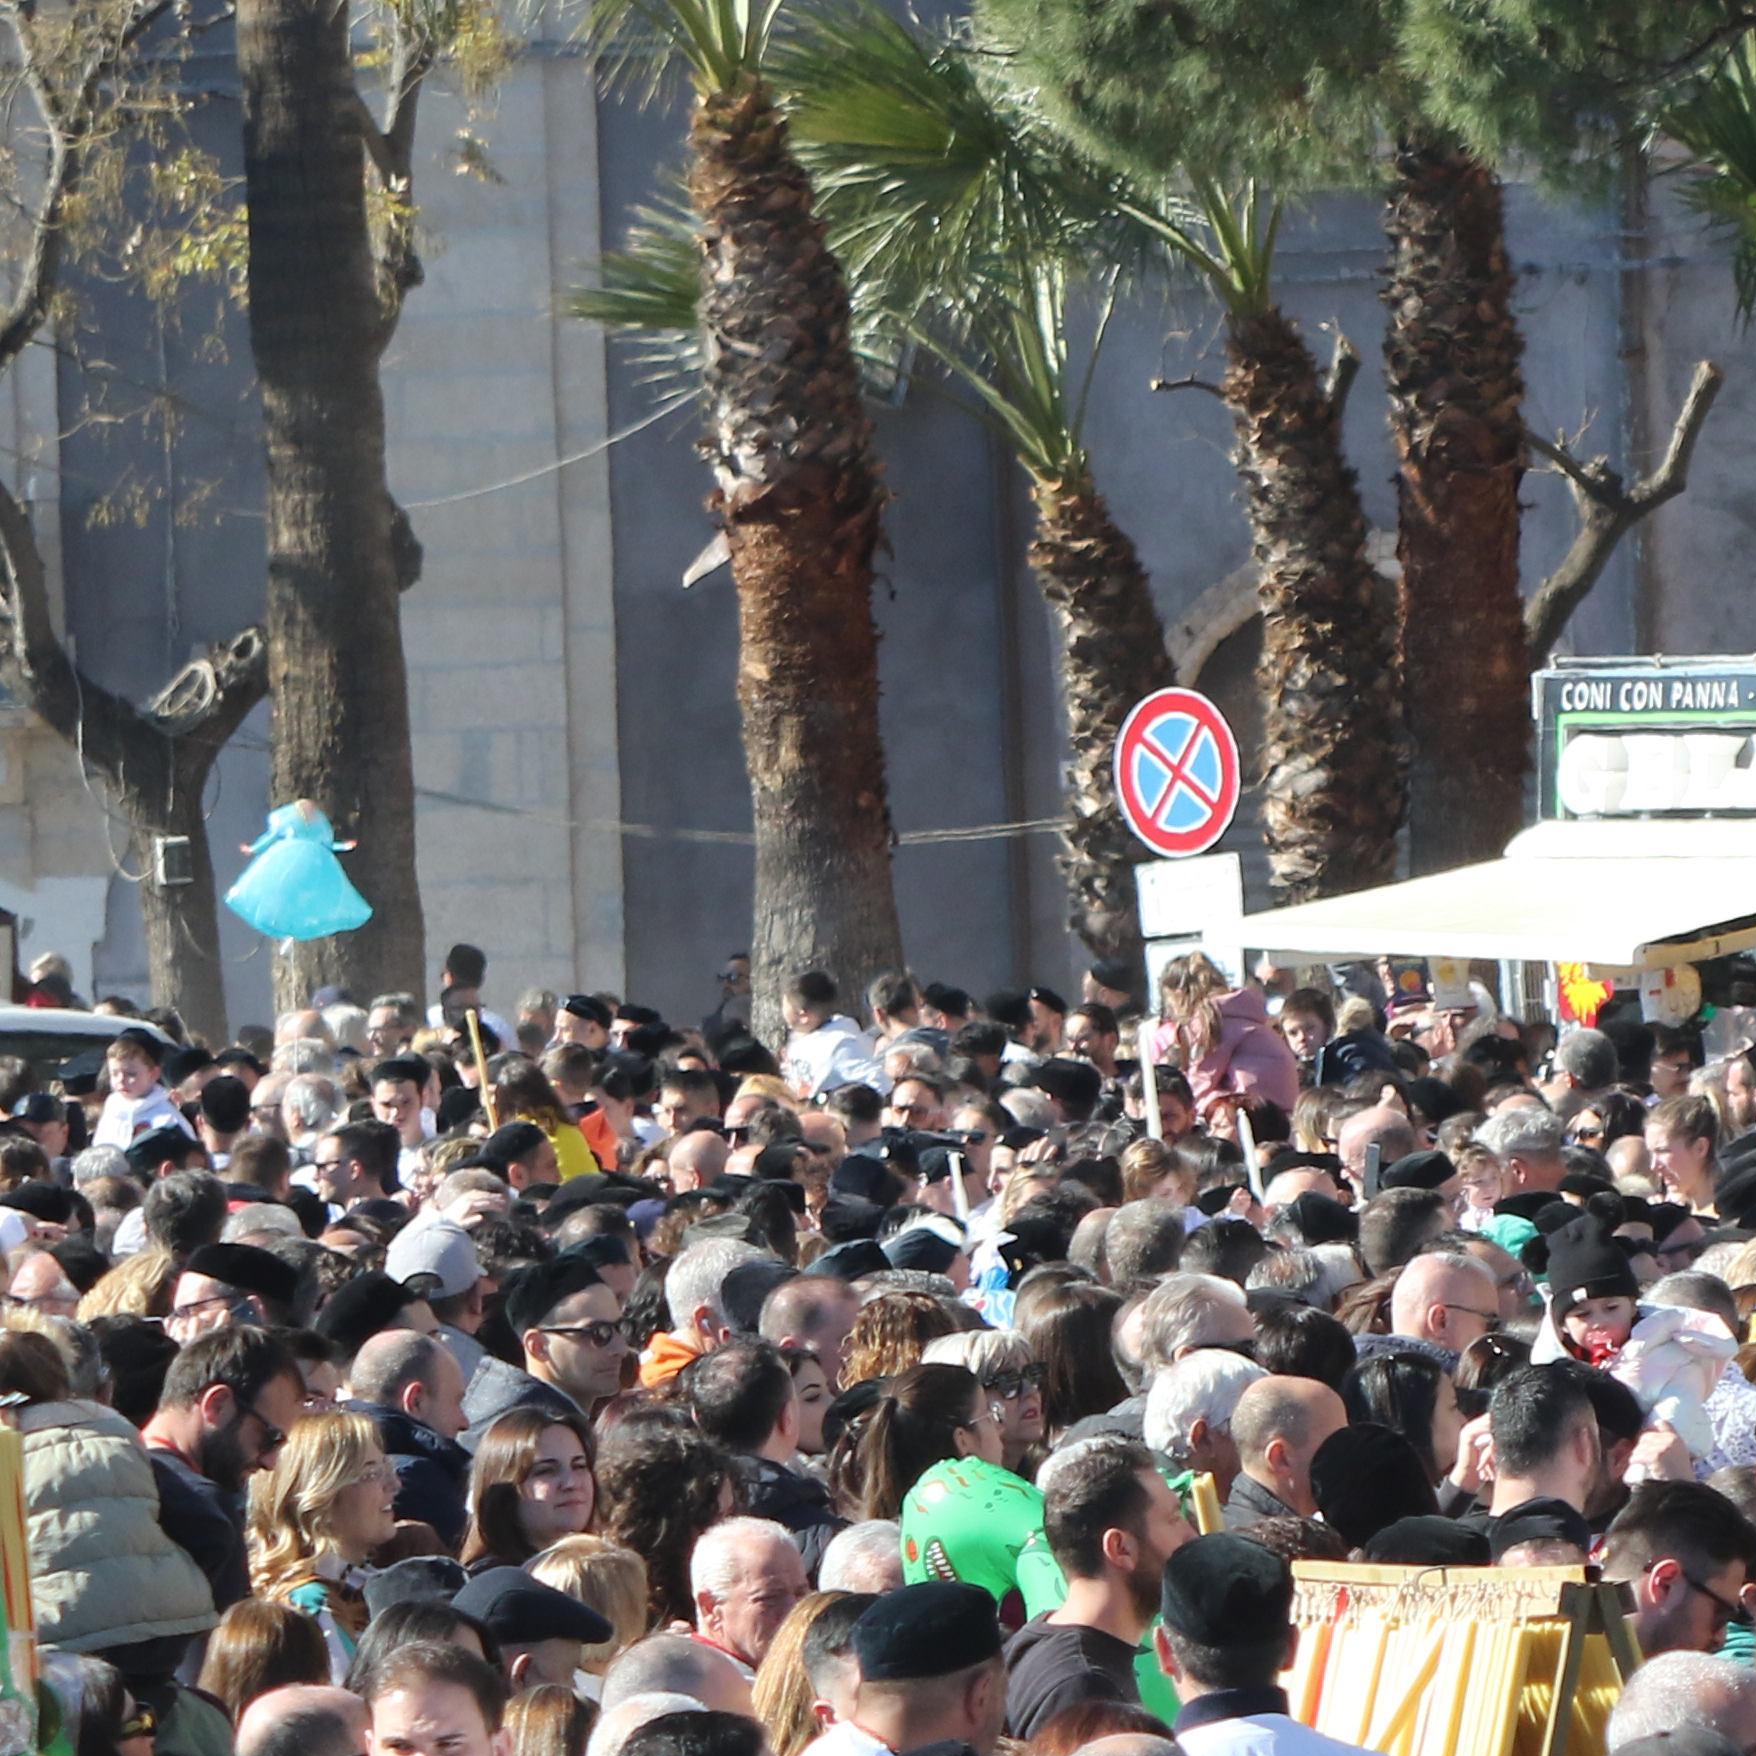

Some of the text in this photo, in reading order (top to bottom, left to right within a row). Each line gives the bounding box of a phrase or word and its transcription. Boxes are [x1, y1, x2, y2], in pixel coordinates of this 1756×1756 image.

[1560, 682, 1611, 712] CONI
[1619, 681, 1663, 711] CON
[1670, 680, 1740, 709] PANNA
